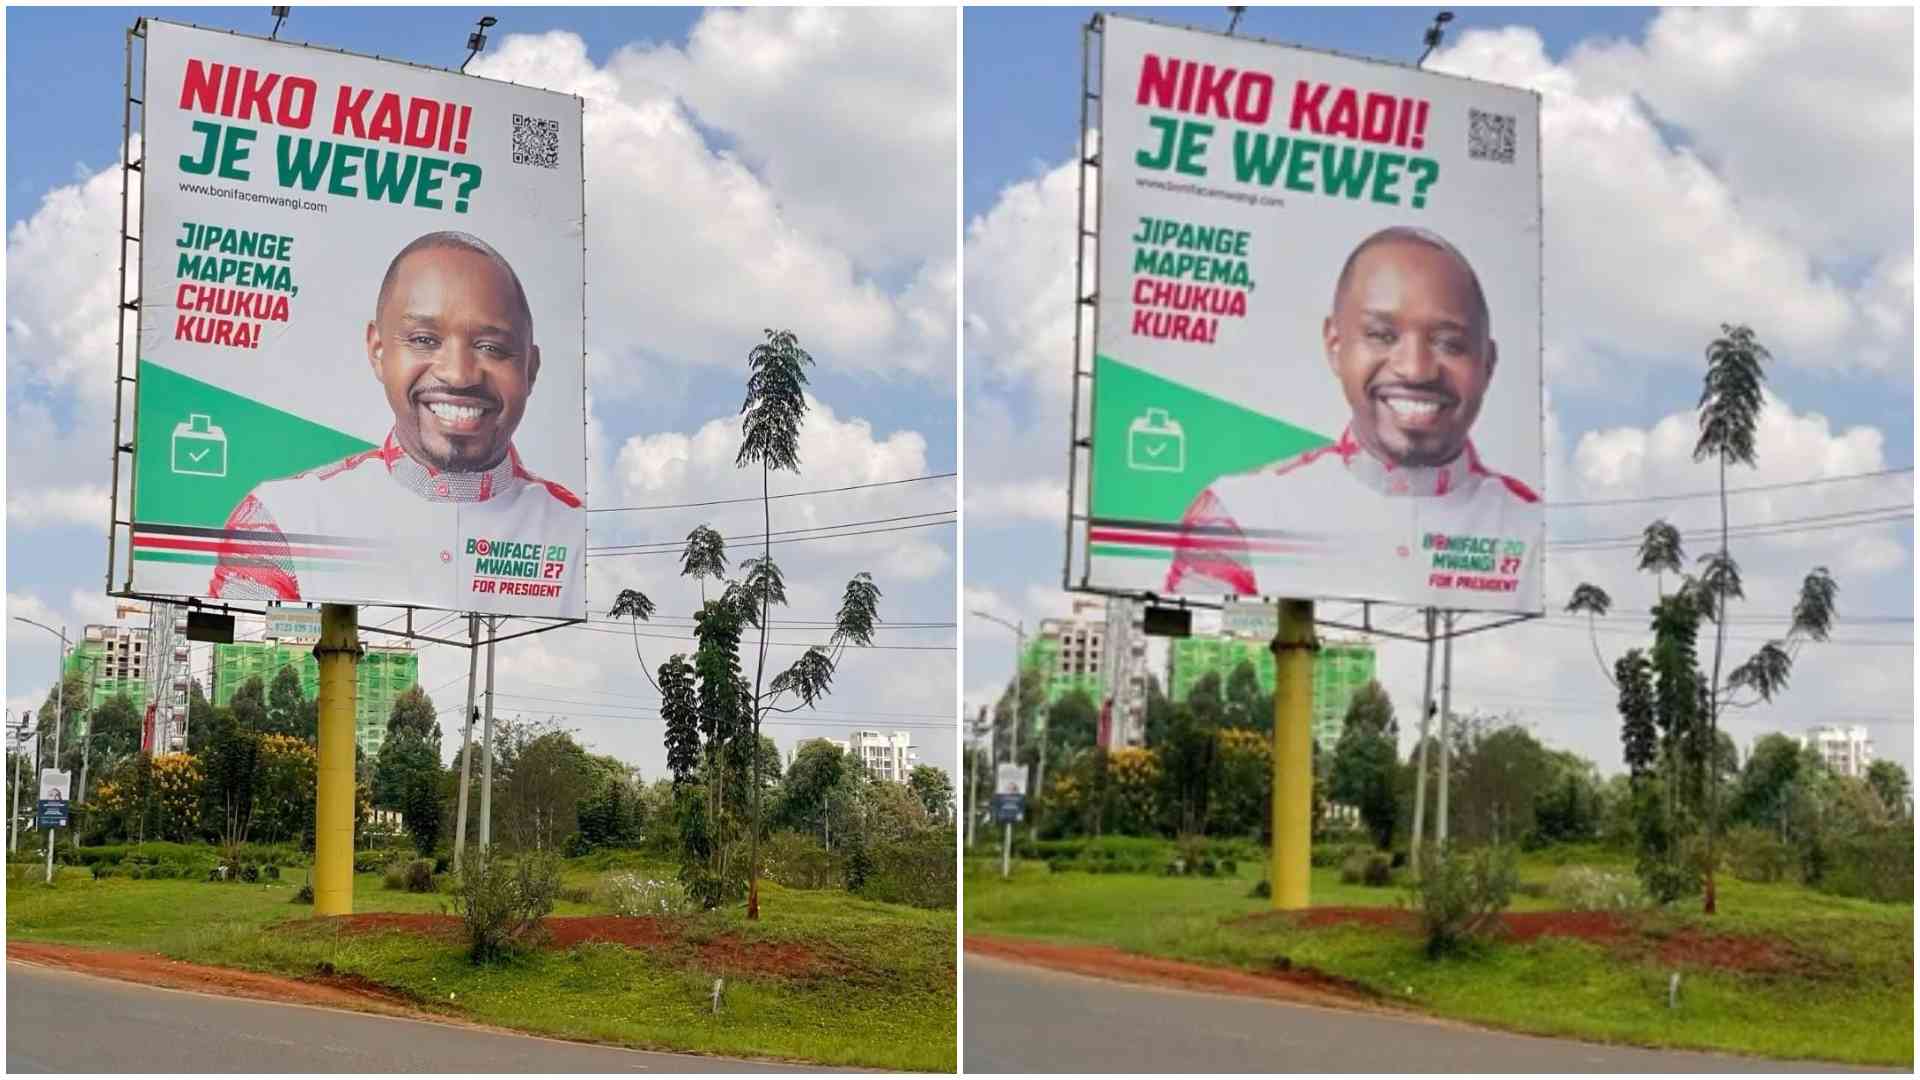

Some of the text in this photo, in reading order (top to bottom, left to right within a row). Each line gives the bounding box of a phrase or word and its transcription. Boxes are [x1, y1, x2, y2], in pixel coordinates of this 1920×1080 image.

[179, 58, 473, 155] NIKO KADI!
[1136, 53, 1430, 150] NIKO KADI!
[178, 119, 482, 213] JE WEWE?
[1135, 116, 1440, 209] JE WEWE?
[178, 182, 328, 213] www.bonifacemwangi.com
[176, 222, 293, 262] JIPANGE
[1132, 217, 1251, 257] JIPANGE
[176, 253, 298, 298] MAPEMA,
[1132, 248, 1256, 292] MAPEMA,
[175, 283, 290, 323] CHUKUA
[1132, 279, 1247, 318] CHUKUA
[175, 315, 262, 349] KURA!
[1131, 310, 1218, 344] KURA!
[465, 538, 543, 561] BONIFACE
[475, 558, 539, 578] MWANGI
[546, 546, 568, 562] 20
[1500, 557, 1521, 574] 27
[472, 579, 562, 598] FOR PRESIDENT
[543, 563, 564, 579] 27
